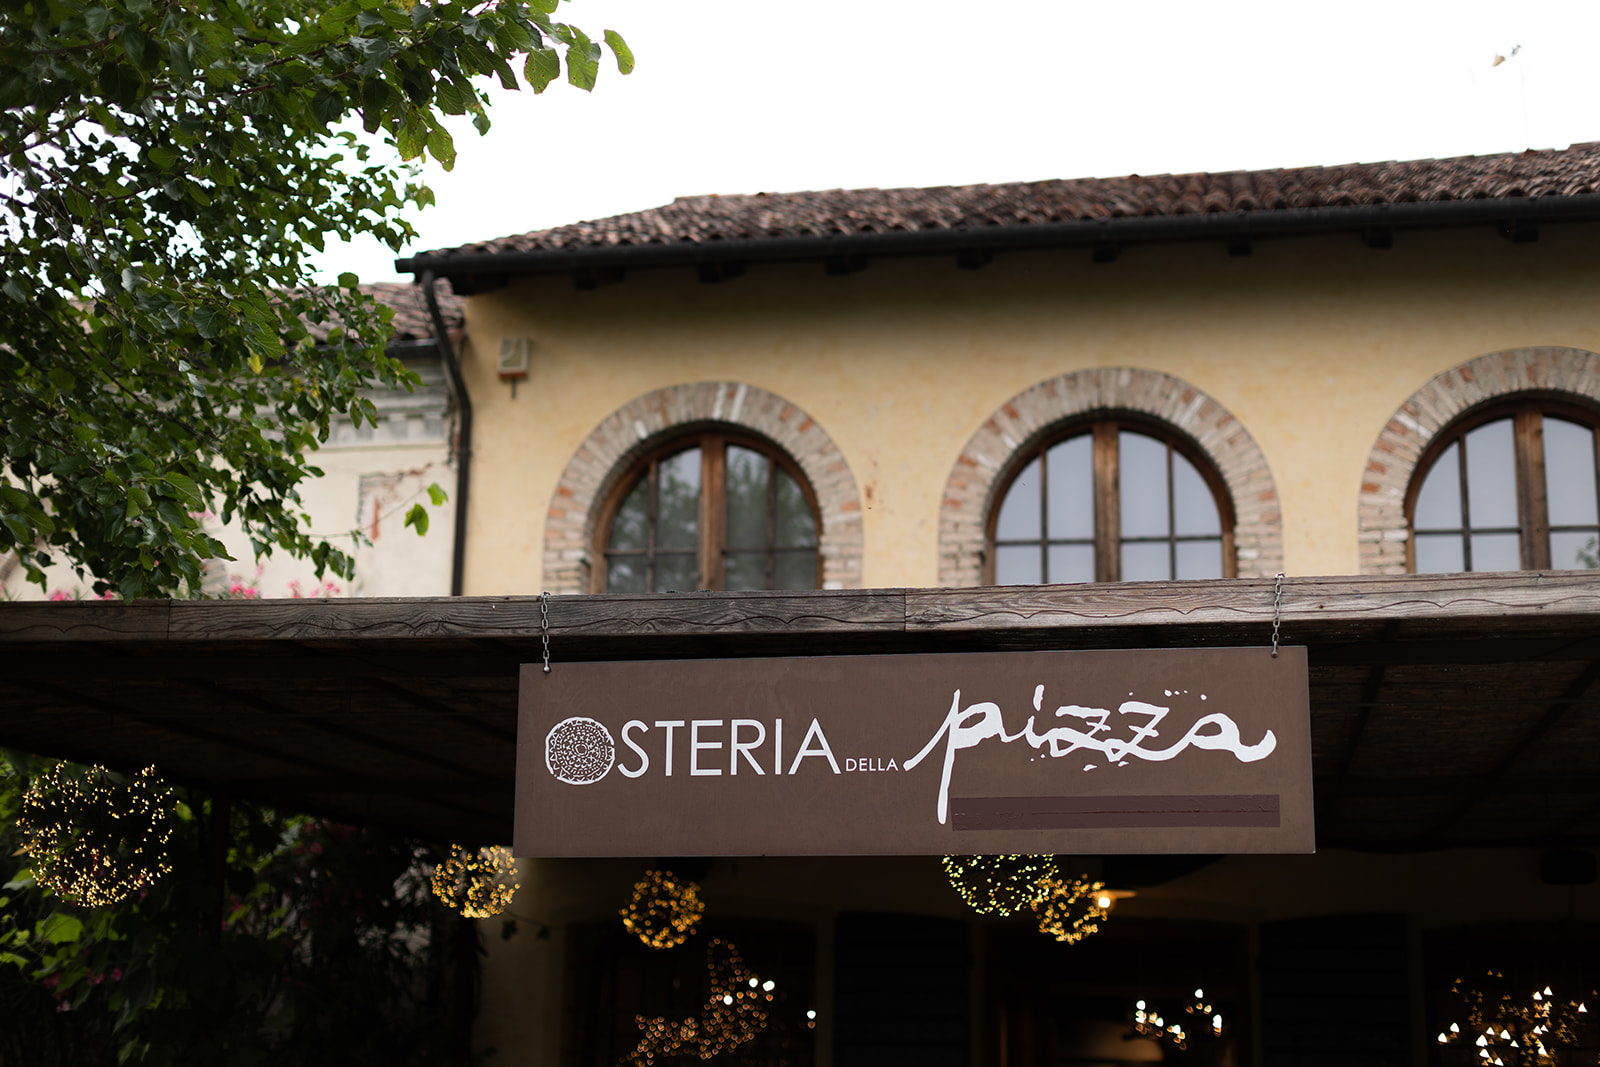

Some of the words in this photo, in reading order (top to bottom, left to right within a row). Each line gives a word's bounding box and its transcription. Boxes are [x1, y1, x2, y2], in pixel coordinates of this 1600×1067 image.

[544, 716, 842, 787] OSTERIA
[845, 757, 899, 772] DELLA
[902, 684, 1277, 825] pizza
